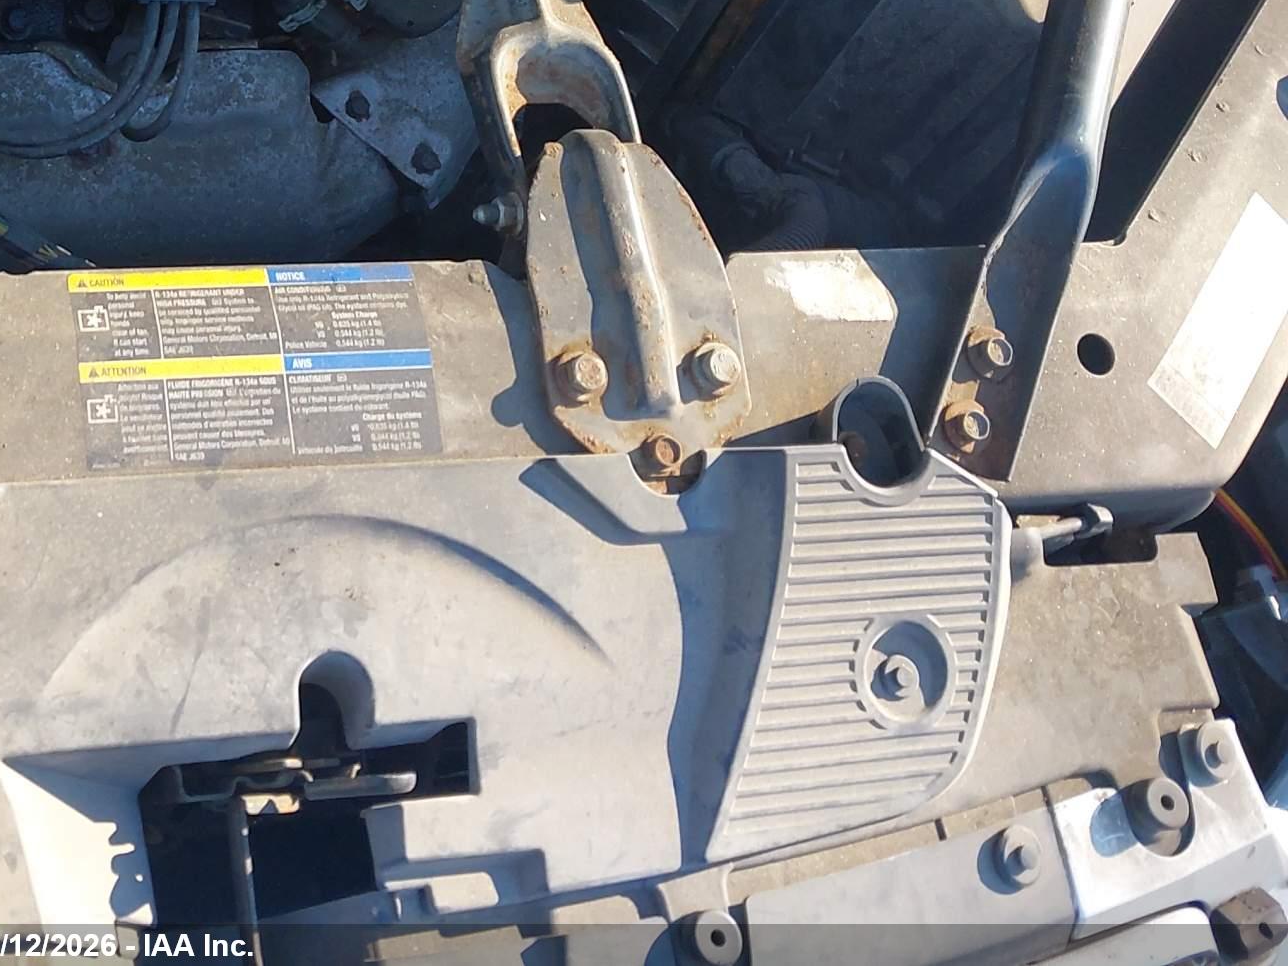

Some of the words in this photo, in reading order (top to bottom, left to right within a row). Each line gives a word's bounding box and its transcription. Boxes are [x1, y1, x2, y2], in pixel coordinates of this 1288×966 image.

[275, 271, 305, 281] NOTICE
[89, 278, 124, 287] CAUTION
[292, 358, 312, 369] AVIS
[101, 367, 146, 377] ATTENTION
